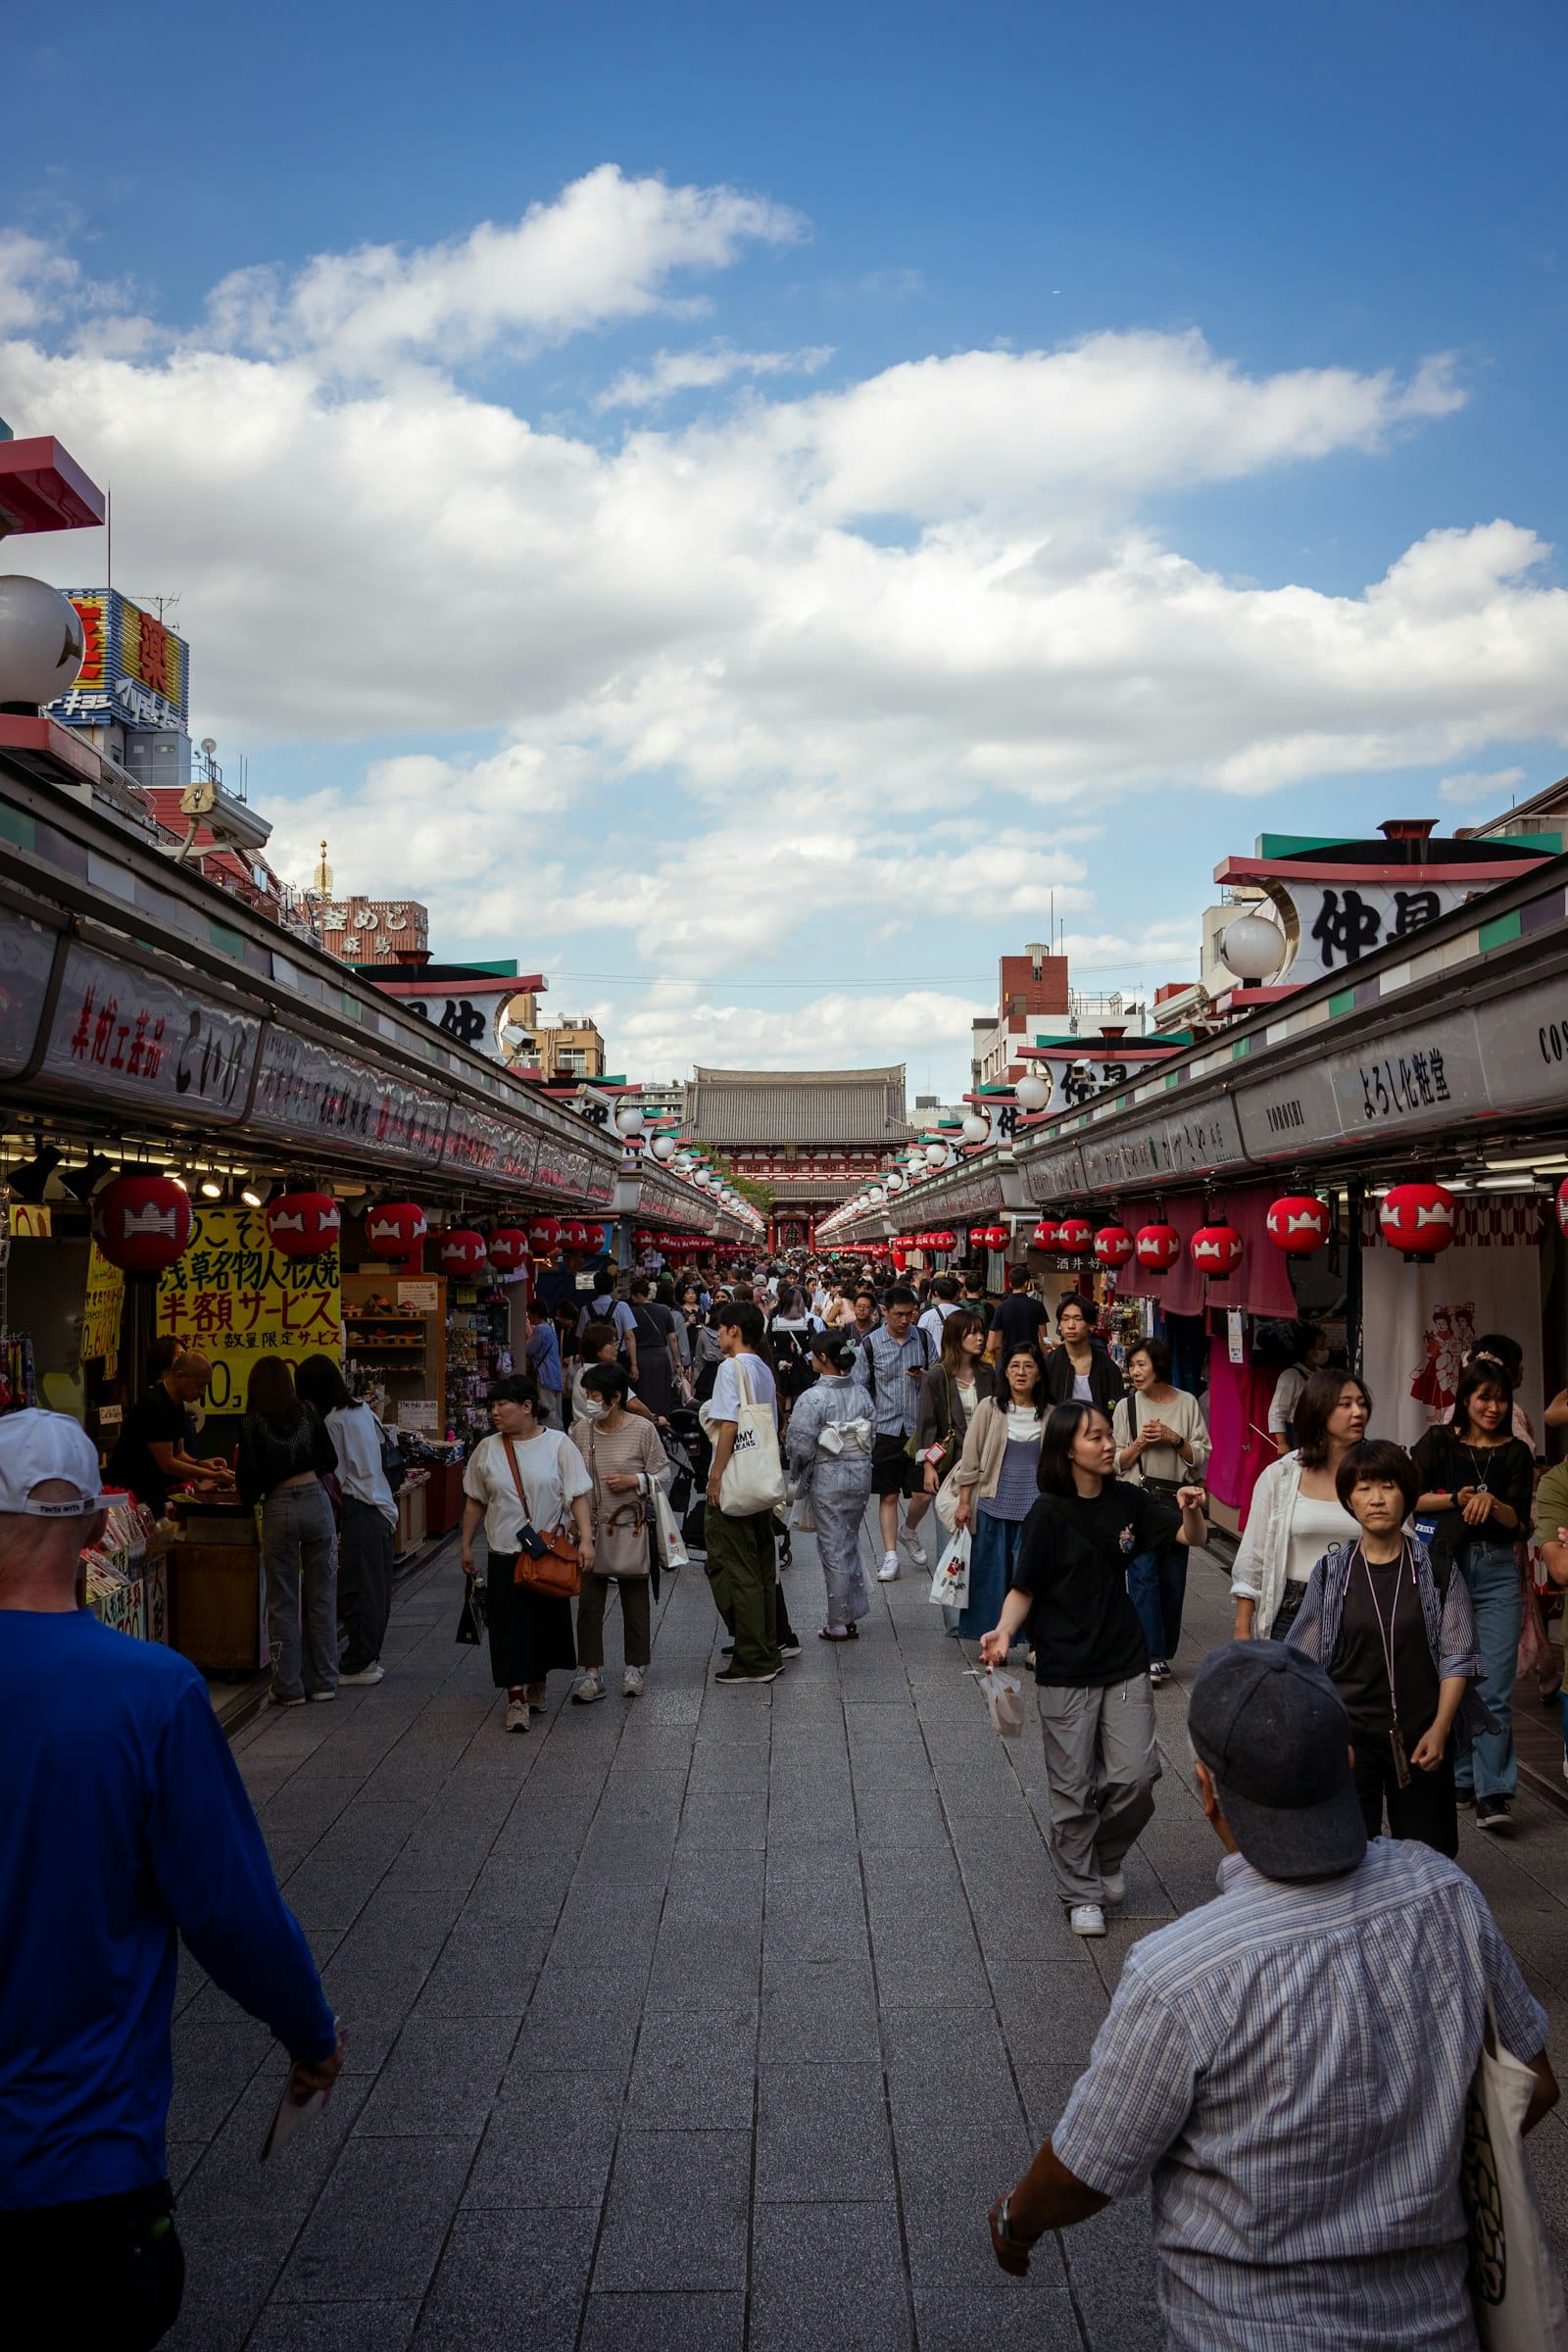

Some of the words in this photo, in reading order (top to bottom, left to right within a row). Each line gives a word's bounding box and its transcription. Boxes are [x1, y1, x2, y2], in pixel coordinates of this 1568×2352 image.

[1358, 1047, 1451, 1120] よろし化粧堂
[1265, 1100, 1305, 1133] YOROSHI
[159, 1292, 339, 1333] 半額サービス
[222, 1332, 293, 1349] 数量限定
[298, 1331, 341, 1348] サービス
